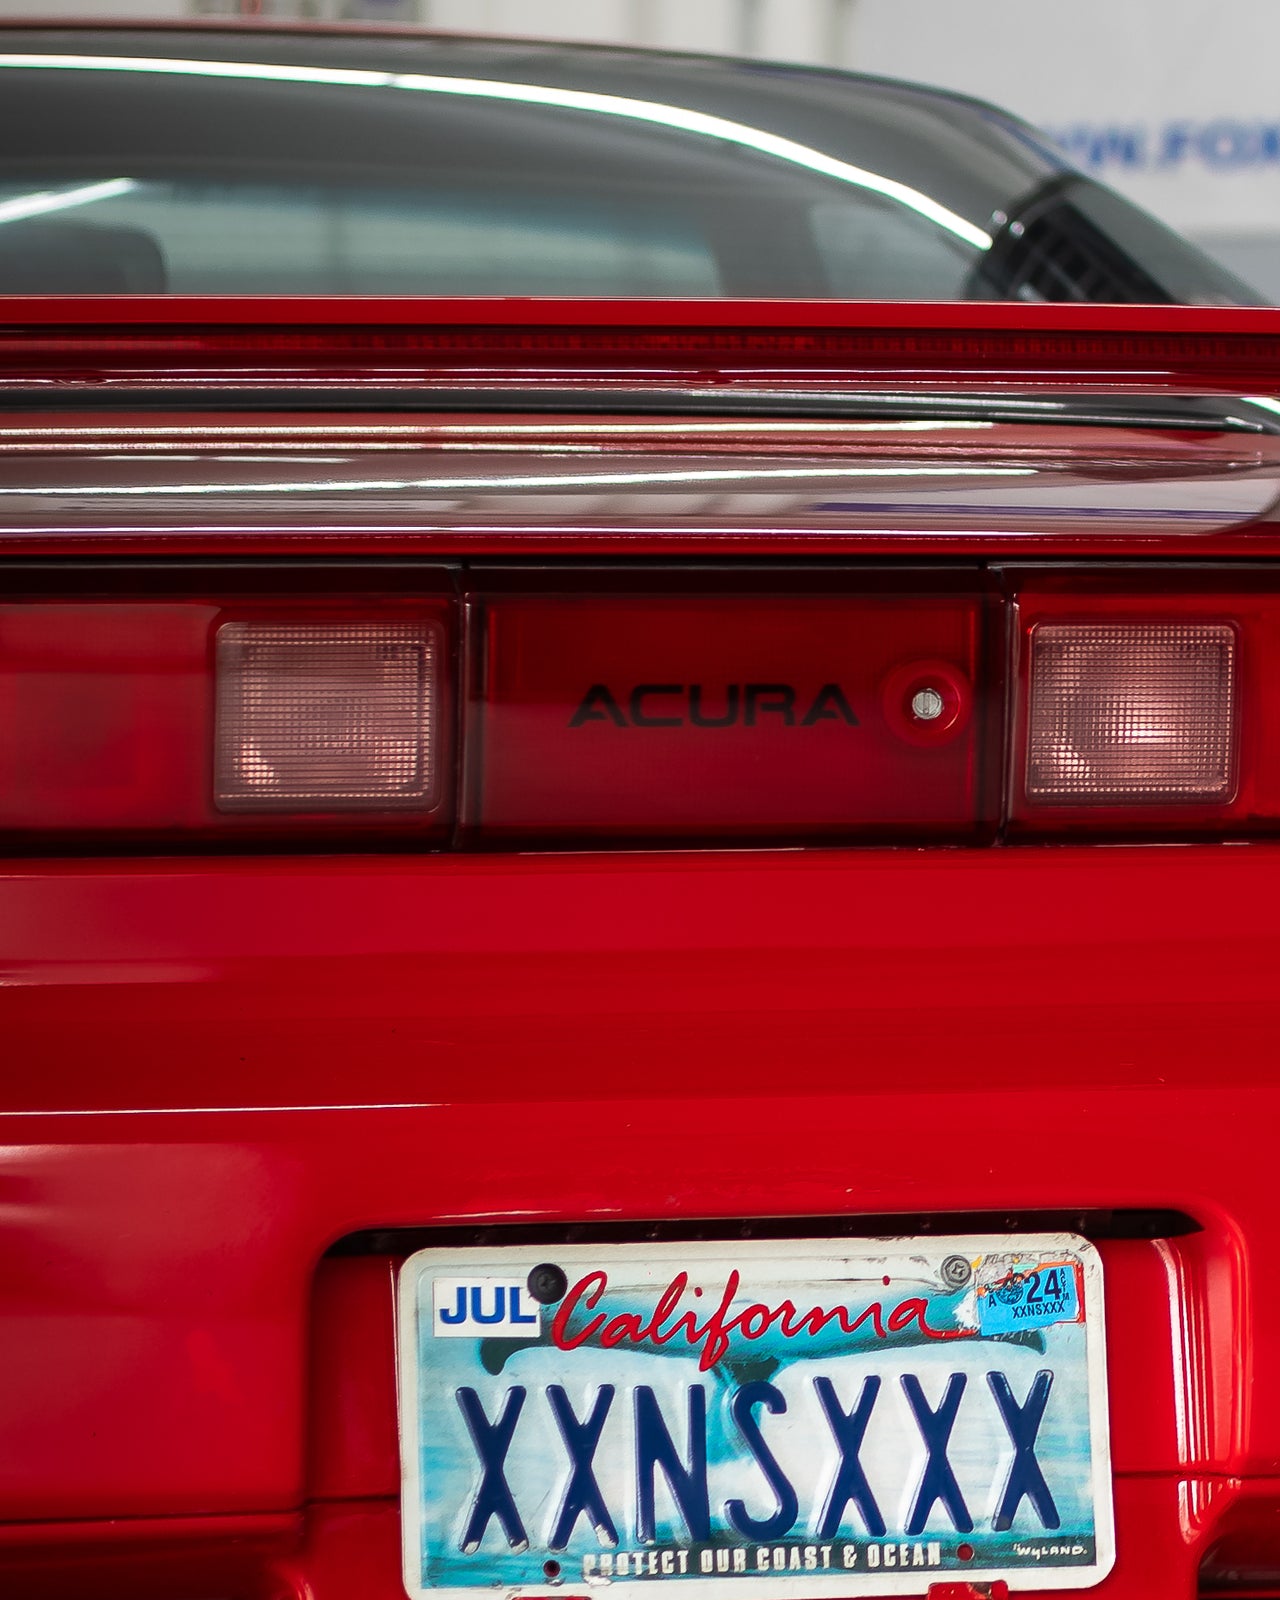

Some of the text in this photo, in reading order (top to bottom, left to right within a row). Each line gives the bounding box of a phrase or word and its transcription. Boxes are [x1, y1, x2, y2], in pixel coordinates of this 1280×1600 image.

[568, 683, 861, 728] ACURA
[439, 1286, 537, 1324] JUL
[1024, 1269, 1062, 1304] 24
[551, 1269, 978, 1372] California
[1011, 1301, 1066, 1319] XXNSXXX
[455, 1369, 1062, 1555] XXNSXXX
[582, 1542, 942, 1577] PROTECT OUR COAST & OCEAN
